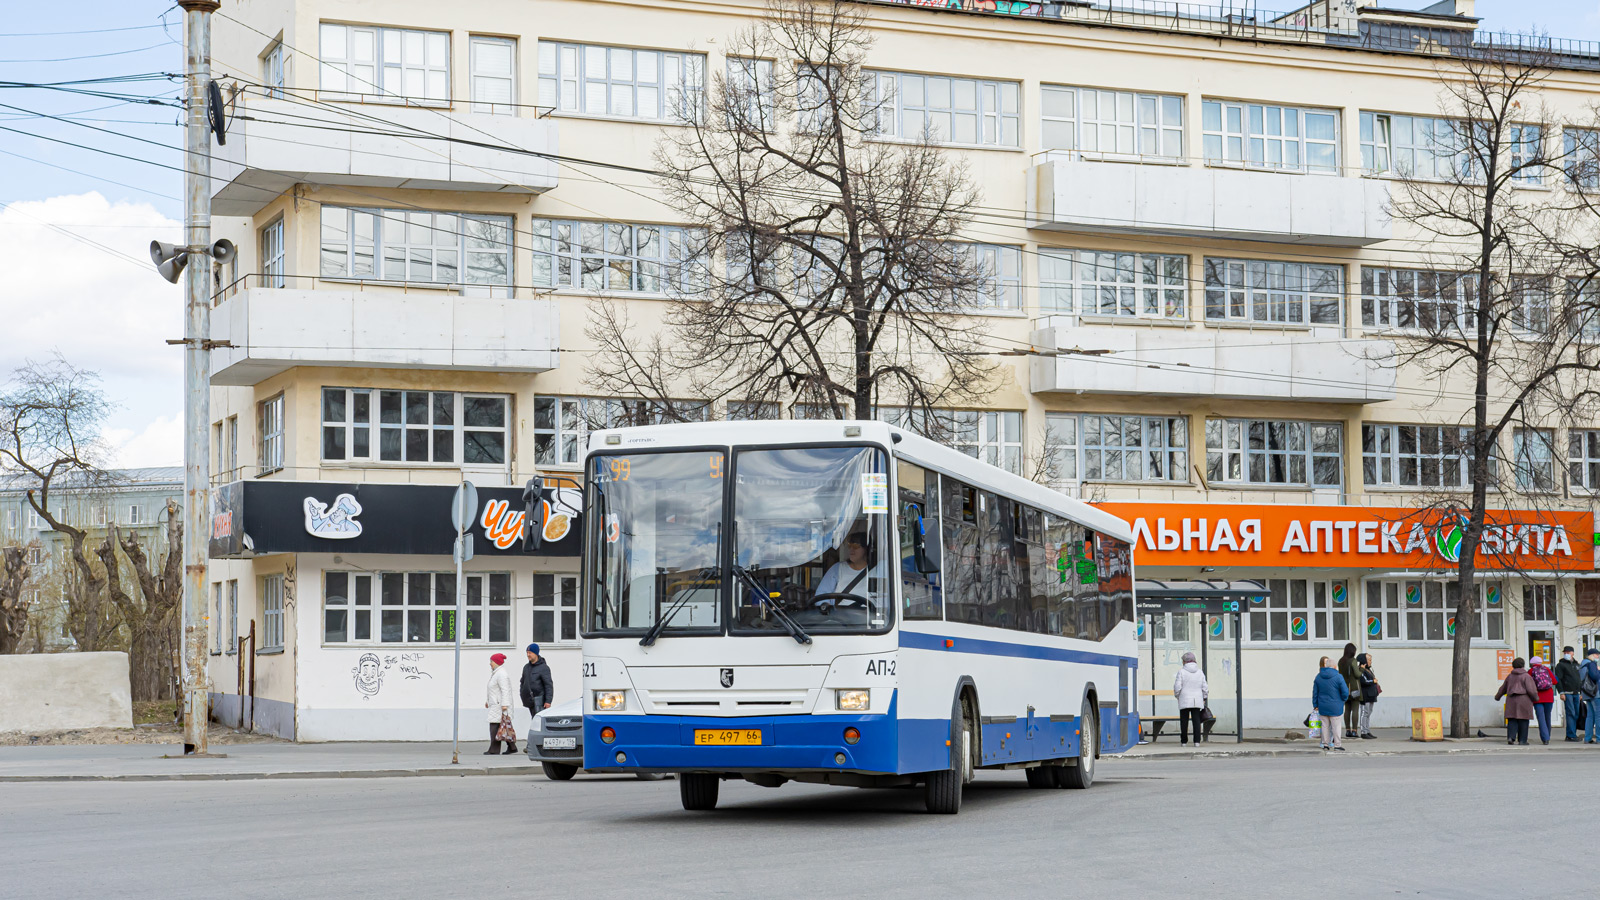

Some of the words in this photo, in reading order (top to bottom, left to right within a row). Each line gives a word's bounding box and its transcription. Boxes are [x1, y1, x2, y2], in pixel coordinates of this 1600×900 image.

[611, 459, 631, 480] 99
[1281, 520, 1432, 554] АПТЕКА
[1481, 523, 1573, 556] ВИТА
[865, 659, 897, 676] АП-2
[719, 731, 740, 743] 497
[746, 731, 758, 740] 66
